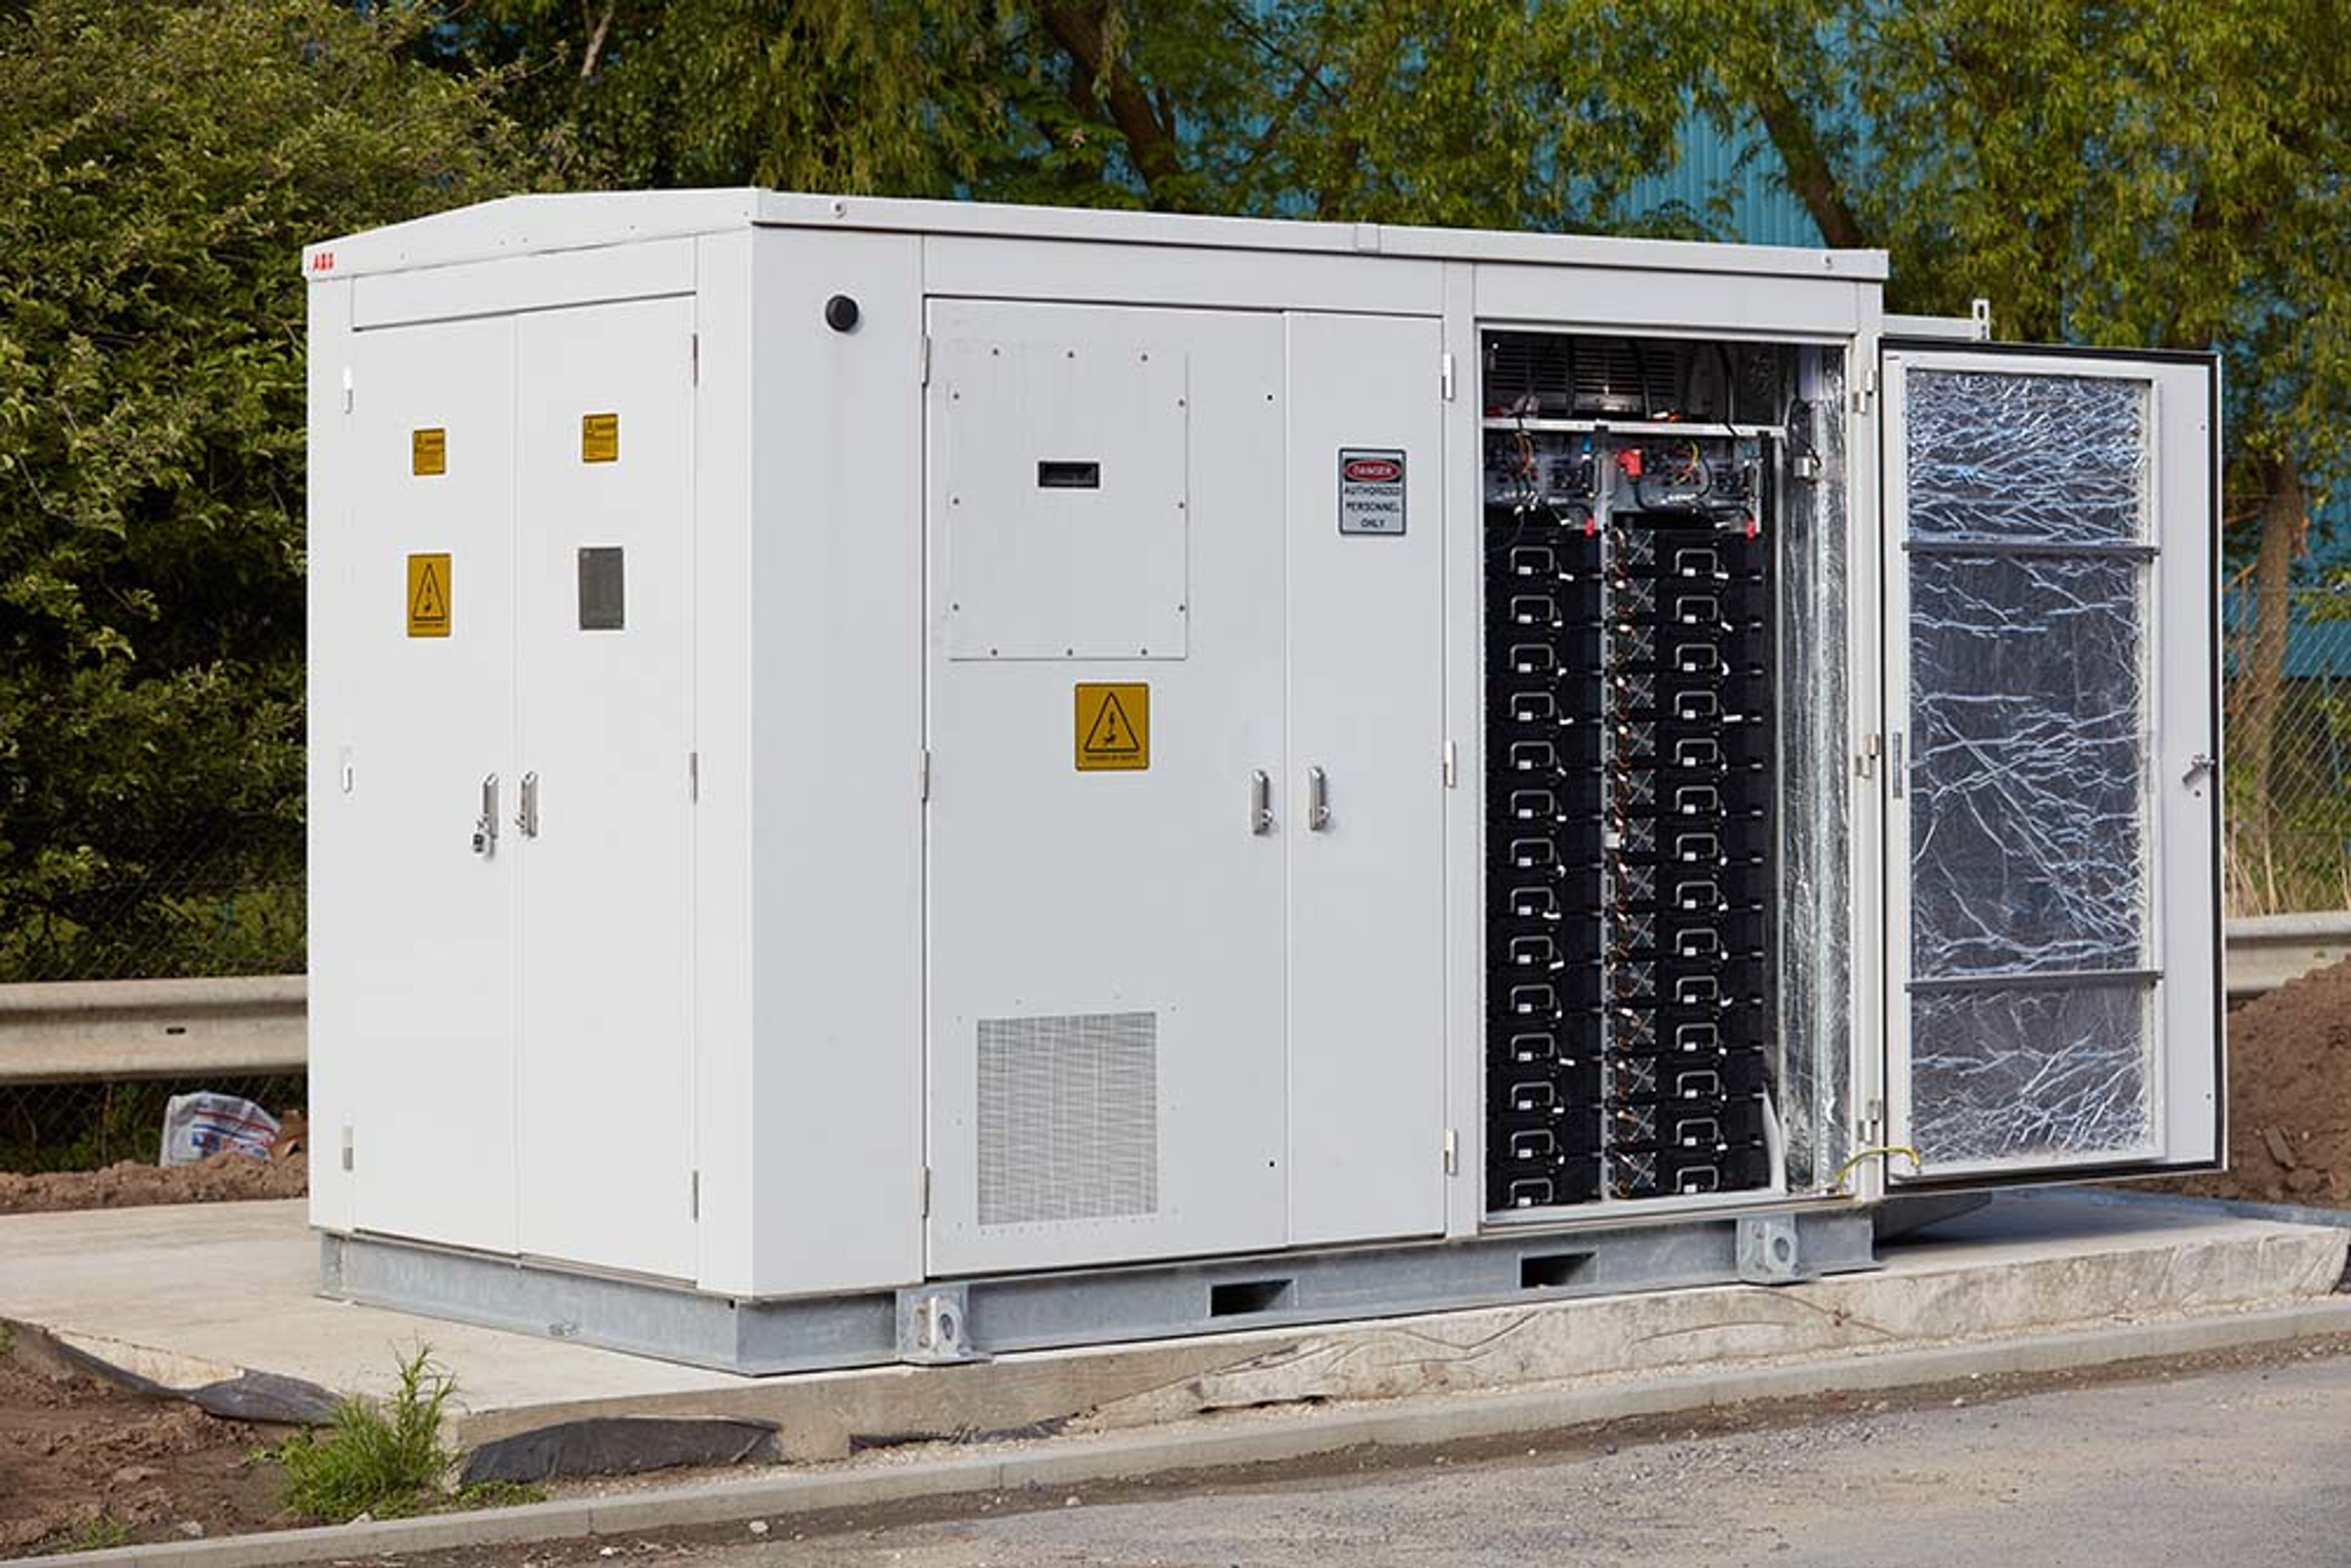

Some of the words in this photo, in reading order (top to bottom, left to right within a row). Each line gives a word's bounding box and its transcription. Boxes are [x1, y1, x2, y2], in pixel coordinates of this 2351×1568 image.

[1353, 465, 1392, 475] DANGER
[1346, 501, 1400, 513] PERSONNEL
[1360, 518, 1385, 528] ONLY
